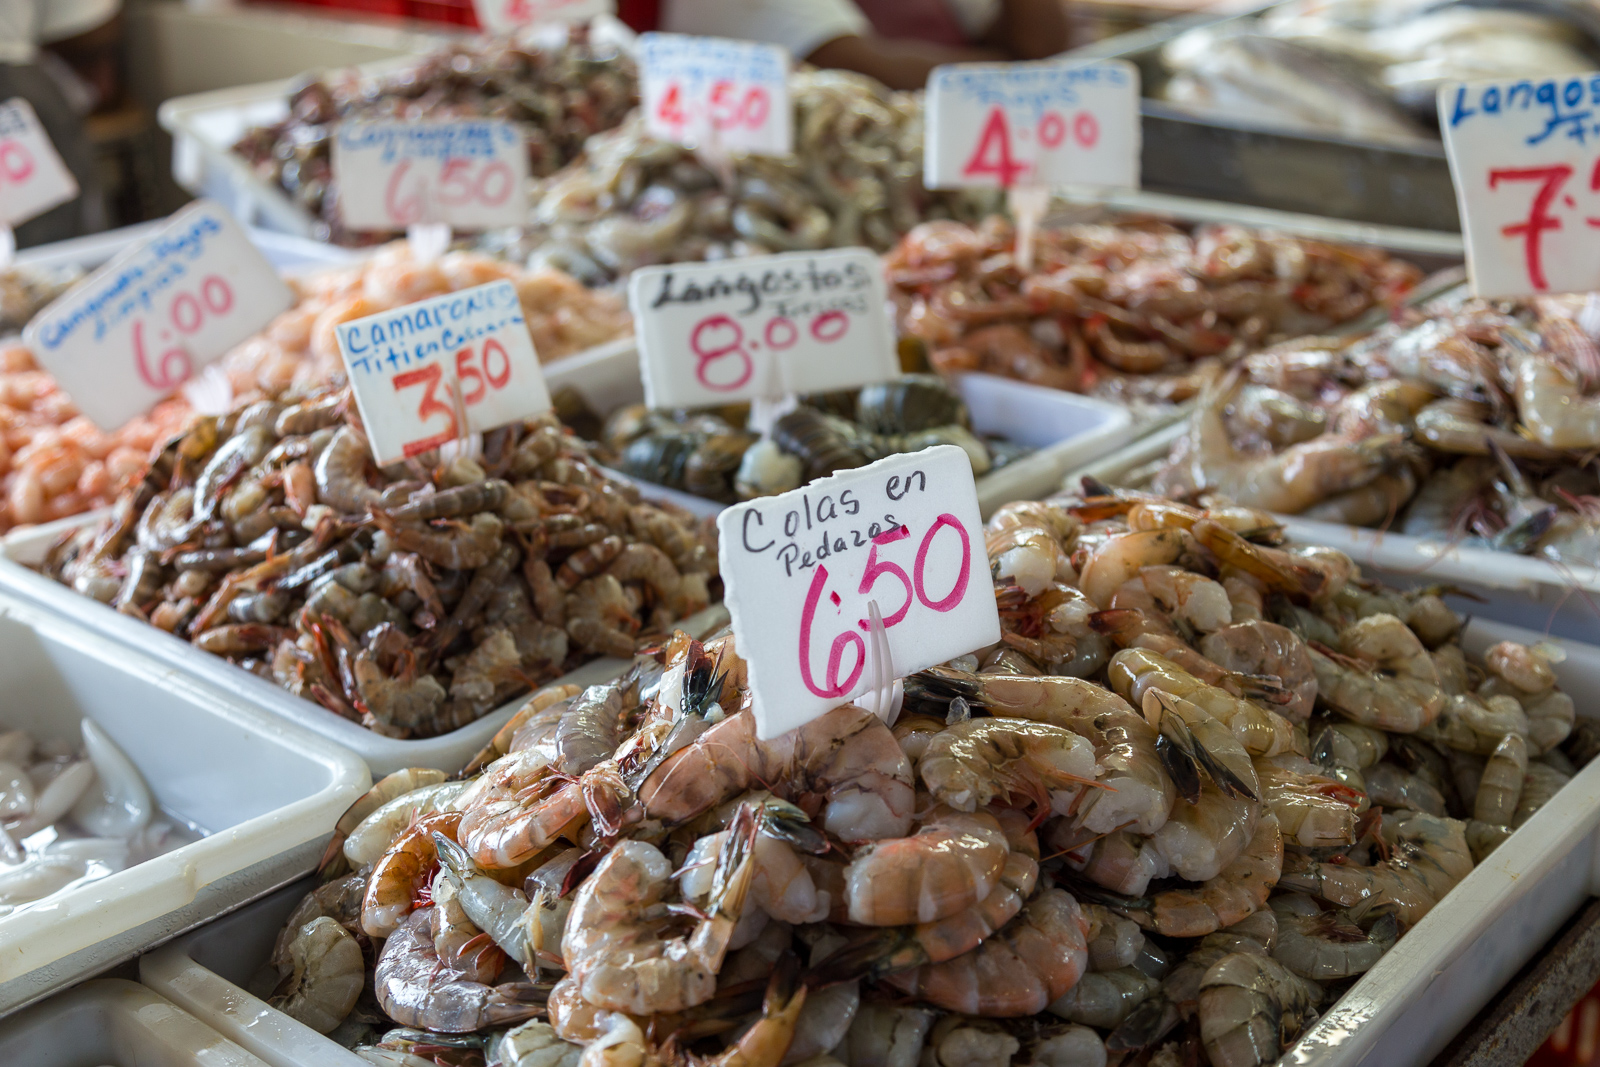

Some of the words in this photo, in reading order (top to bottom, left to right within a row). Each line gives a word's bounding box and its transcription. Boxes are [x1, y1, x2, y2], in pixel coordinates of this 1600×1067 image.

[961, 102, 1100, 188] 4.00
[132, 273, 236, 391] 6.00
[690, 311, 851, 392] 8.00
[743, 489, 860, 553] Colas
[886, 470, 926, 501] en
[777, 514, 901, 577] Pedazos
[799, 513, 971, 699] 6.50
